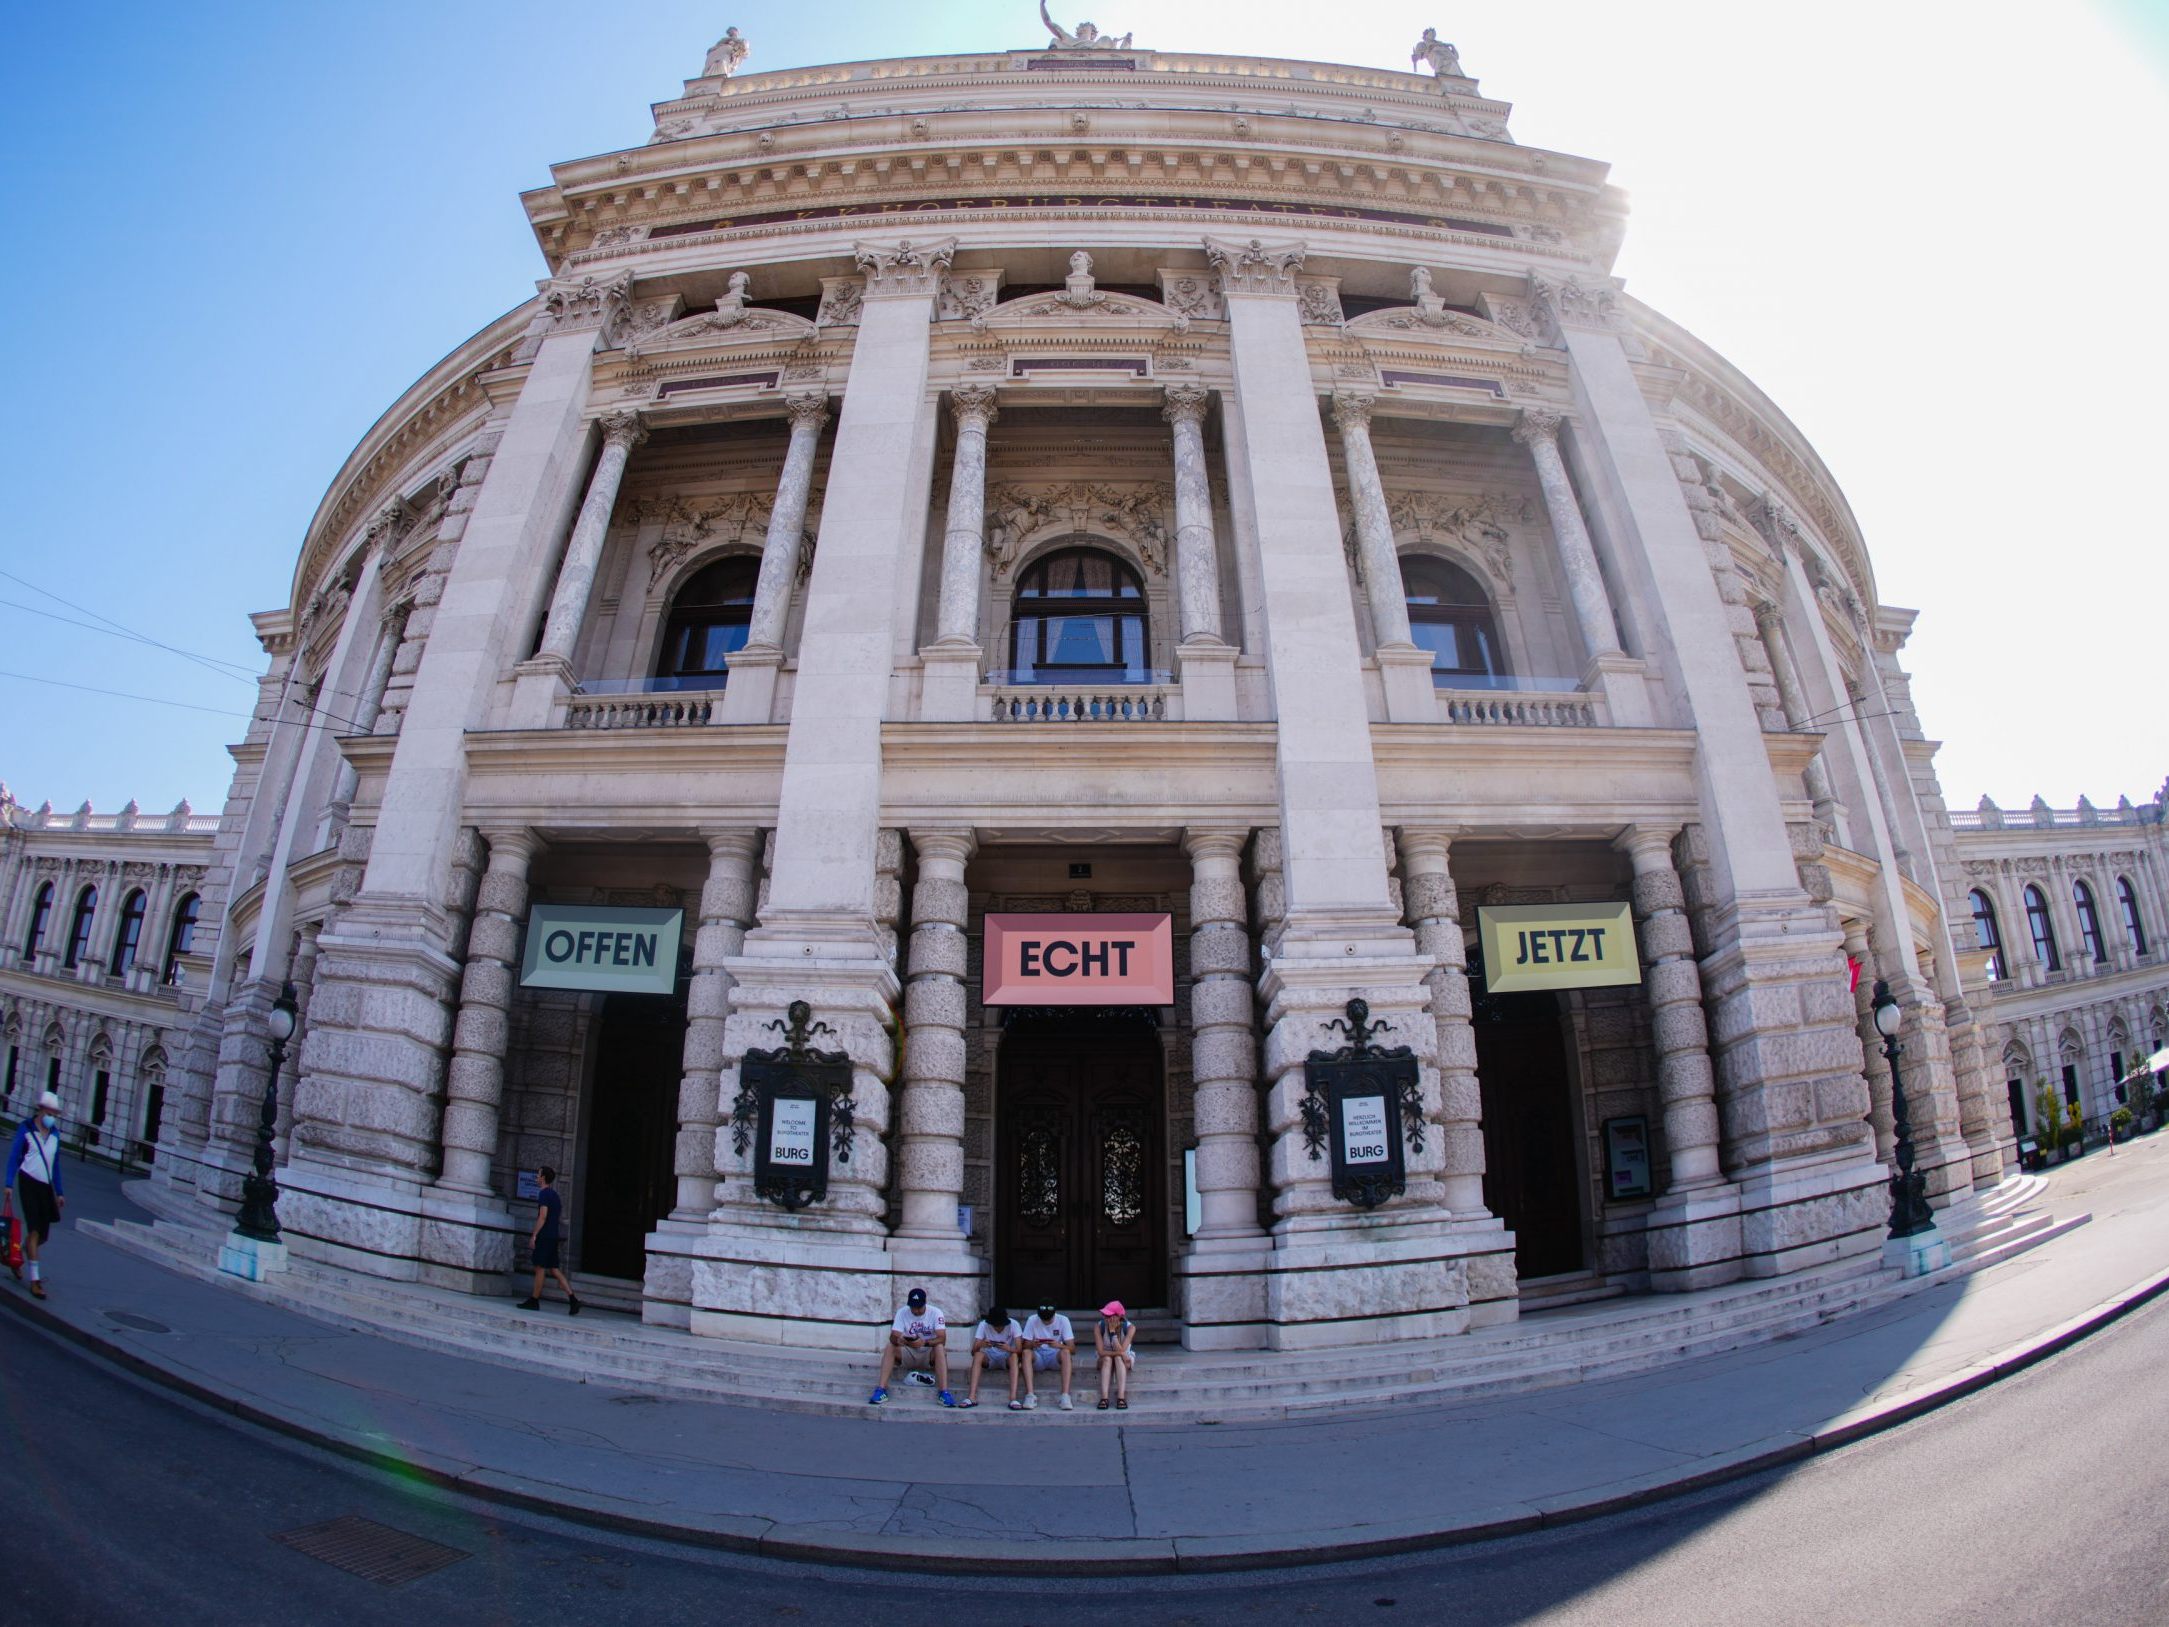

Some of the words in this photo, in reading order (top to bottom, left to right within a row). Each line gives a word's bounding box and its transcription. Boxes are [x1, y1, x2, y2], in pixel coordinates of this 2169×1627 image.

[545, 929, 658, 967] OFFEN
[1020, 940, 1135, 977] ECHT
[1516, 928, 1606, 965] JETZT
[775, 1146, 809, 1160] BURG
[1350, 1144, 1384, 1159] BURG
